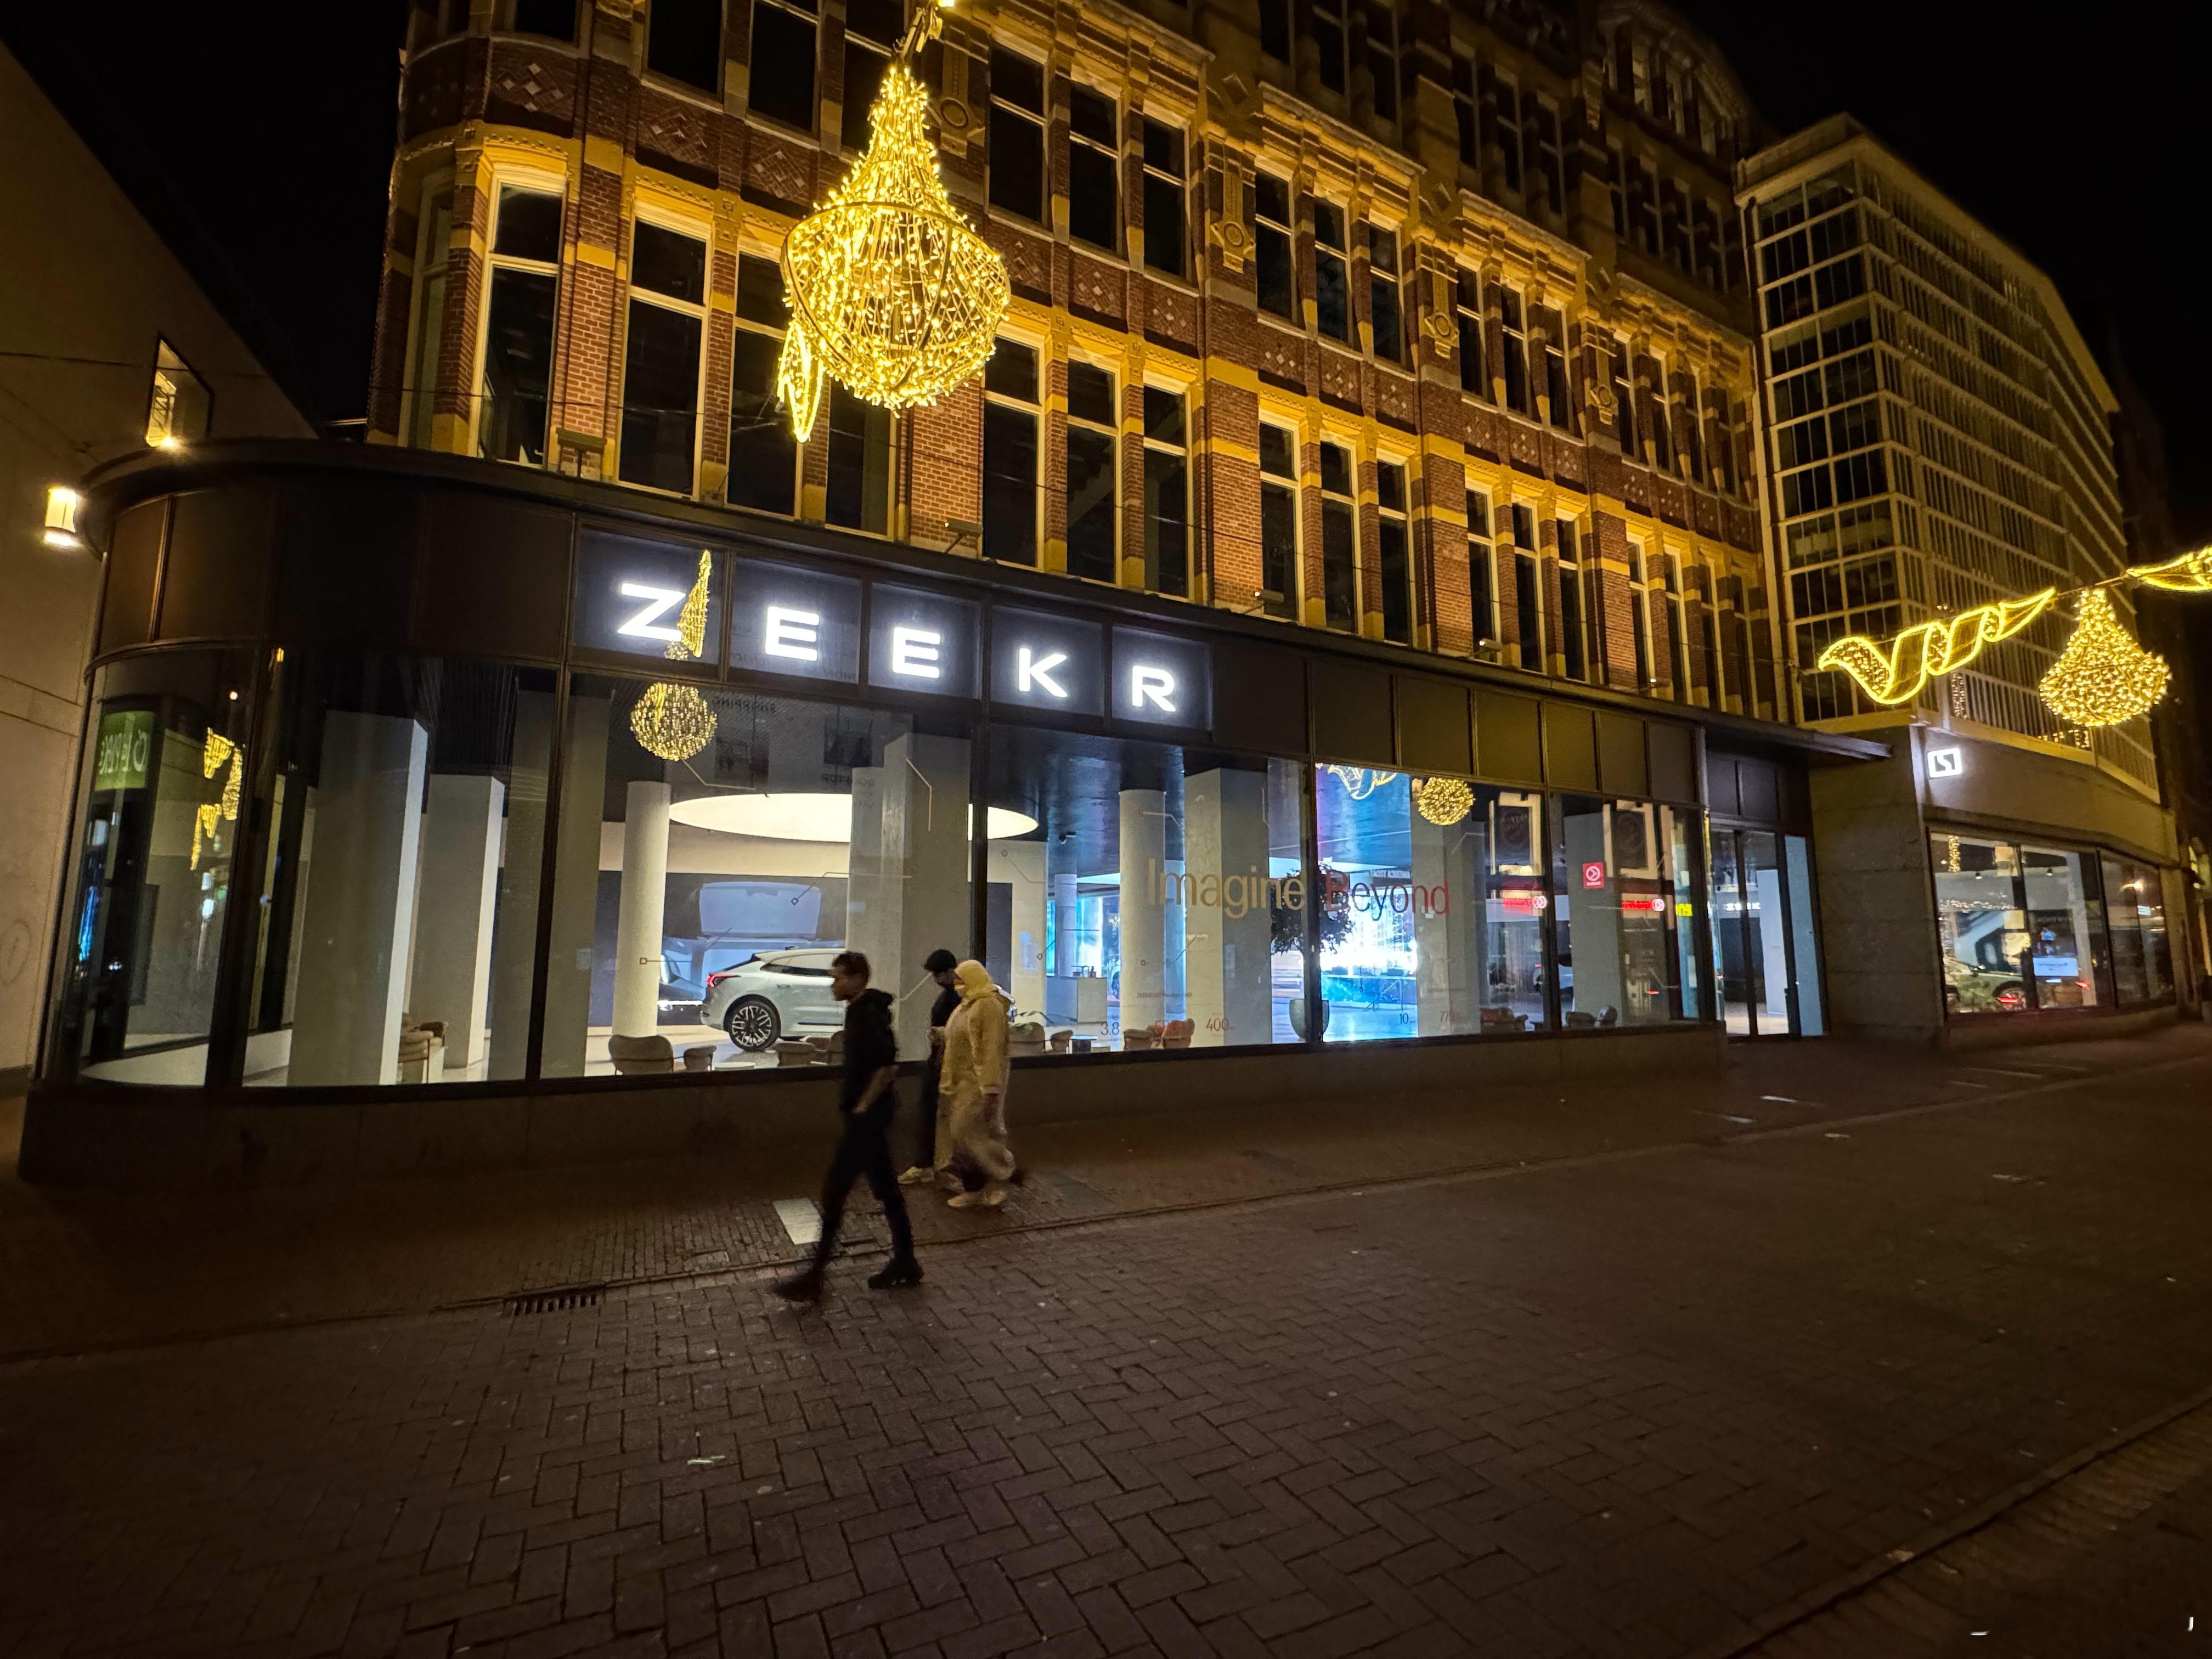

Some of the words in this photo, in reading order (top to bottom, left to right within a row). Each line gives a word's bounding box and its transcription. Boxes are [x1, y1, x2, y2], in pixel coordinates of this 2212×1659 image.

[617, 583, 1176, 713] ZEEKR
[1148, 858, 1306, 919] Imagine
[1324, 871, 1449, 922] Beyond
[1101, 1022, 1120, 1036] 3.8
[1206, 1018, 1229, 1031] 400
